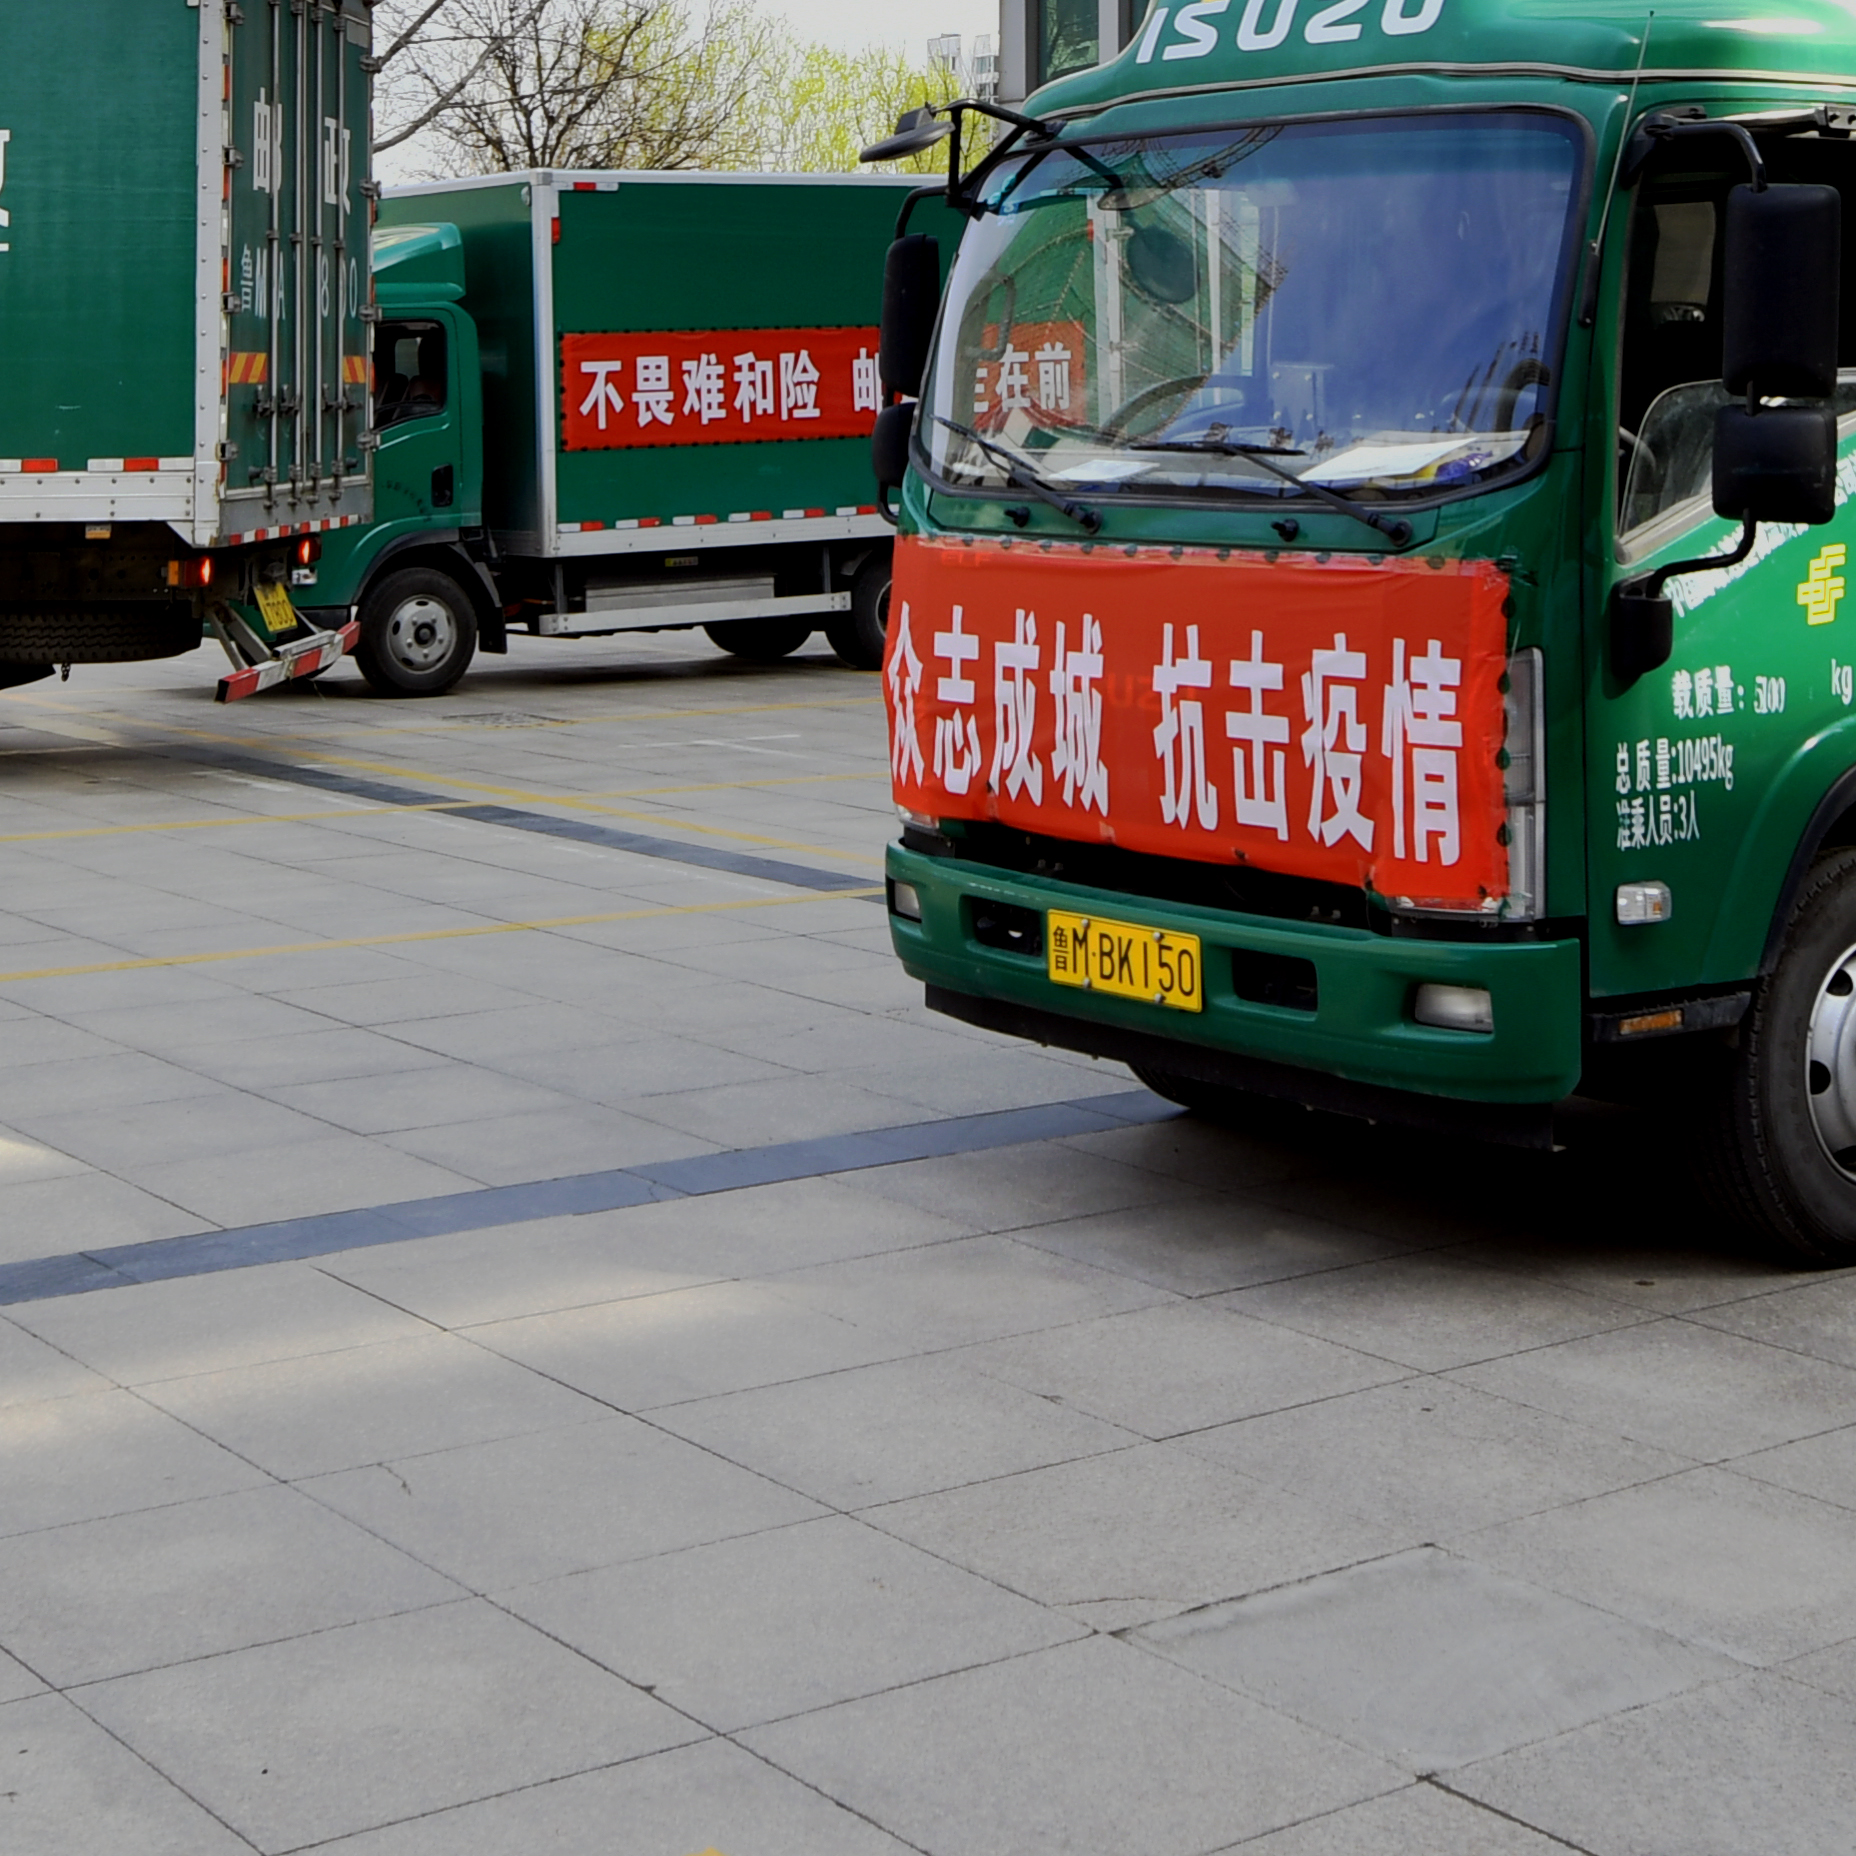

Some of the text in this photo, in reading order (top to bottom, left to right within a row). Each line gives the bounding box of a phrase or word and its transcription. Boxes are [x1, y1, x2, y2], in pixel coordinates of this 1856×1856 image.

[579, 349, 821, 430] 不畏难和险
[1831, 658, 1853, 705] kg
[888, 601, 1463, 866] 众志成城 抗击疫情
